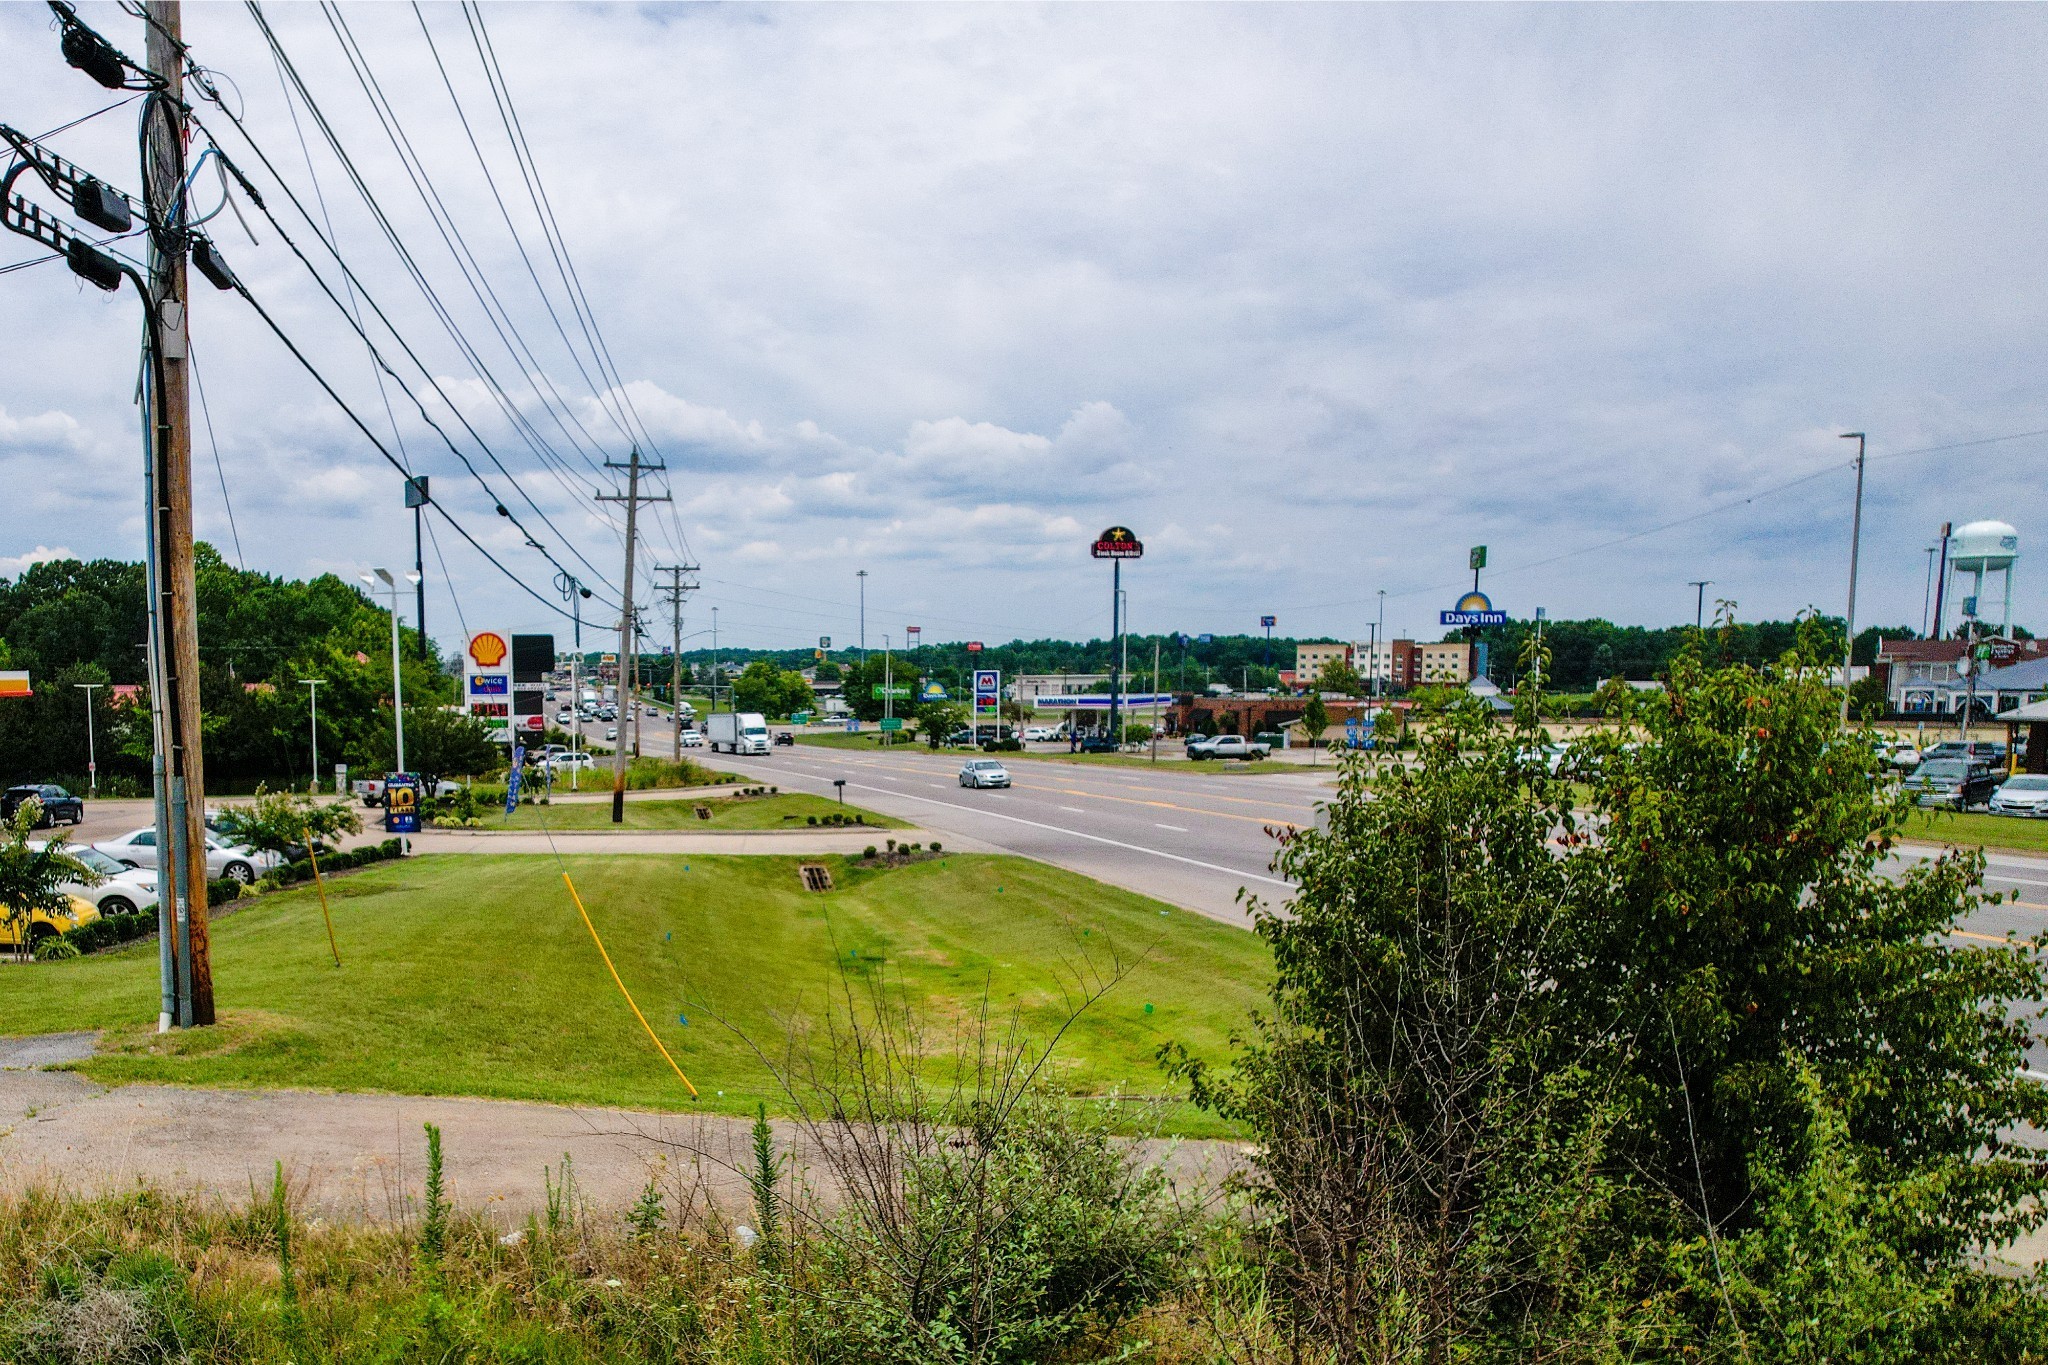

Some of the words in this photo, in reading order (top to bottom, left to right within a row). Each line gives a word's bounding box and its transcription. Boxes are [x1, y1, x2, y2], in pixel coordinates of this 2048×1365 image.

[1445, 612, 1479, 625] Days
[1480, 612, 1503, 624] Inn
[388, 787, 415, 806] 10
